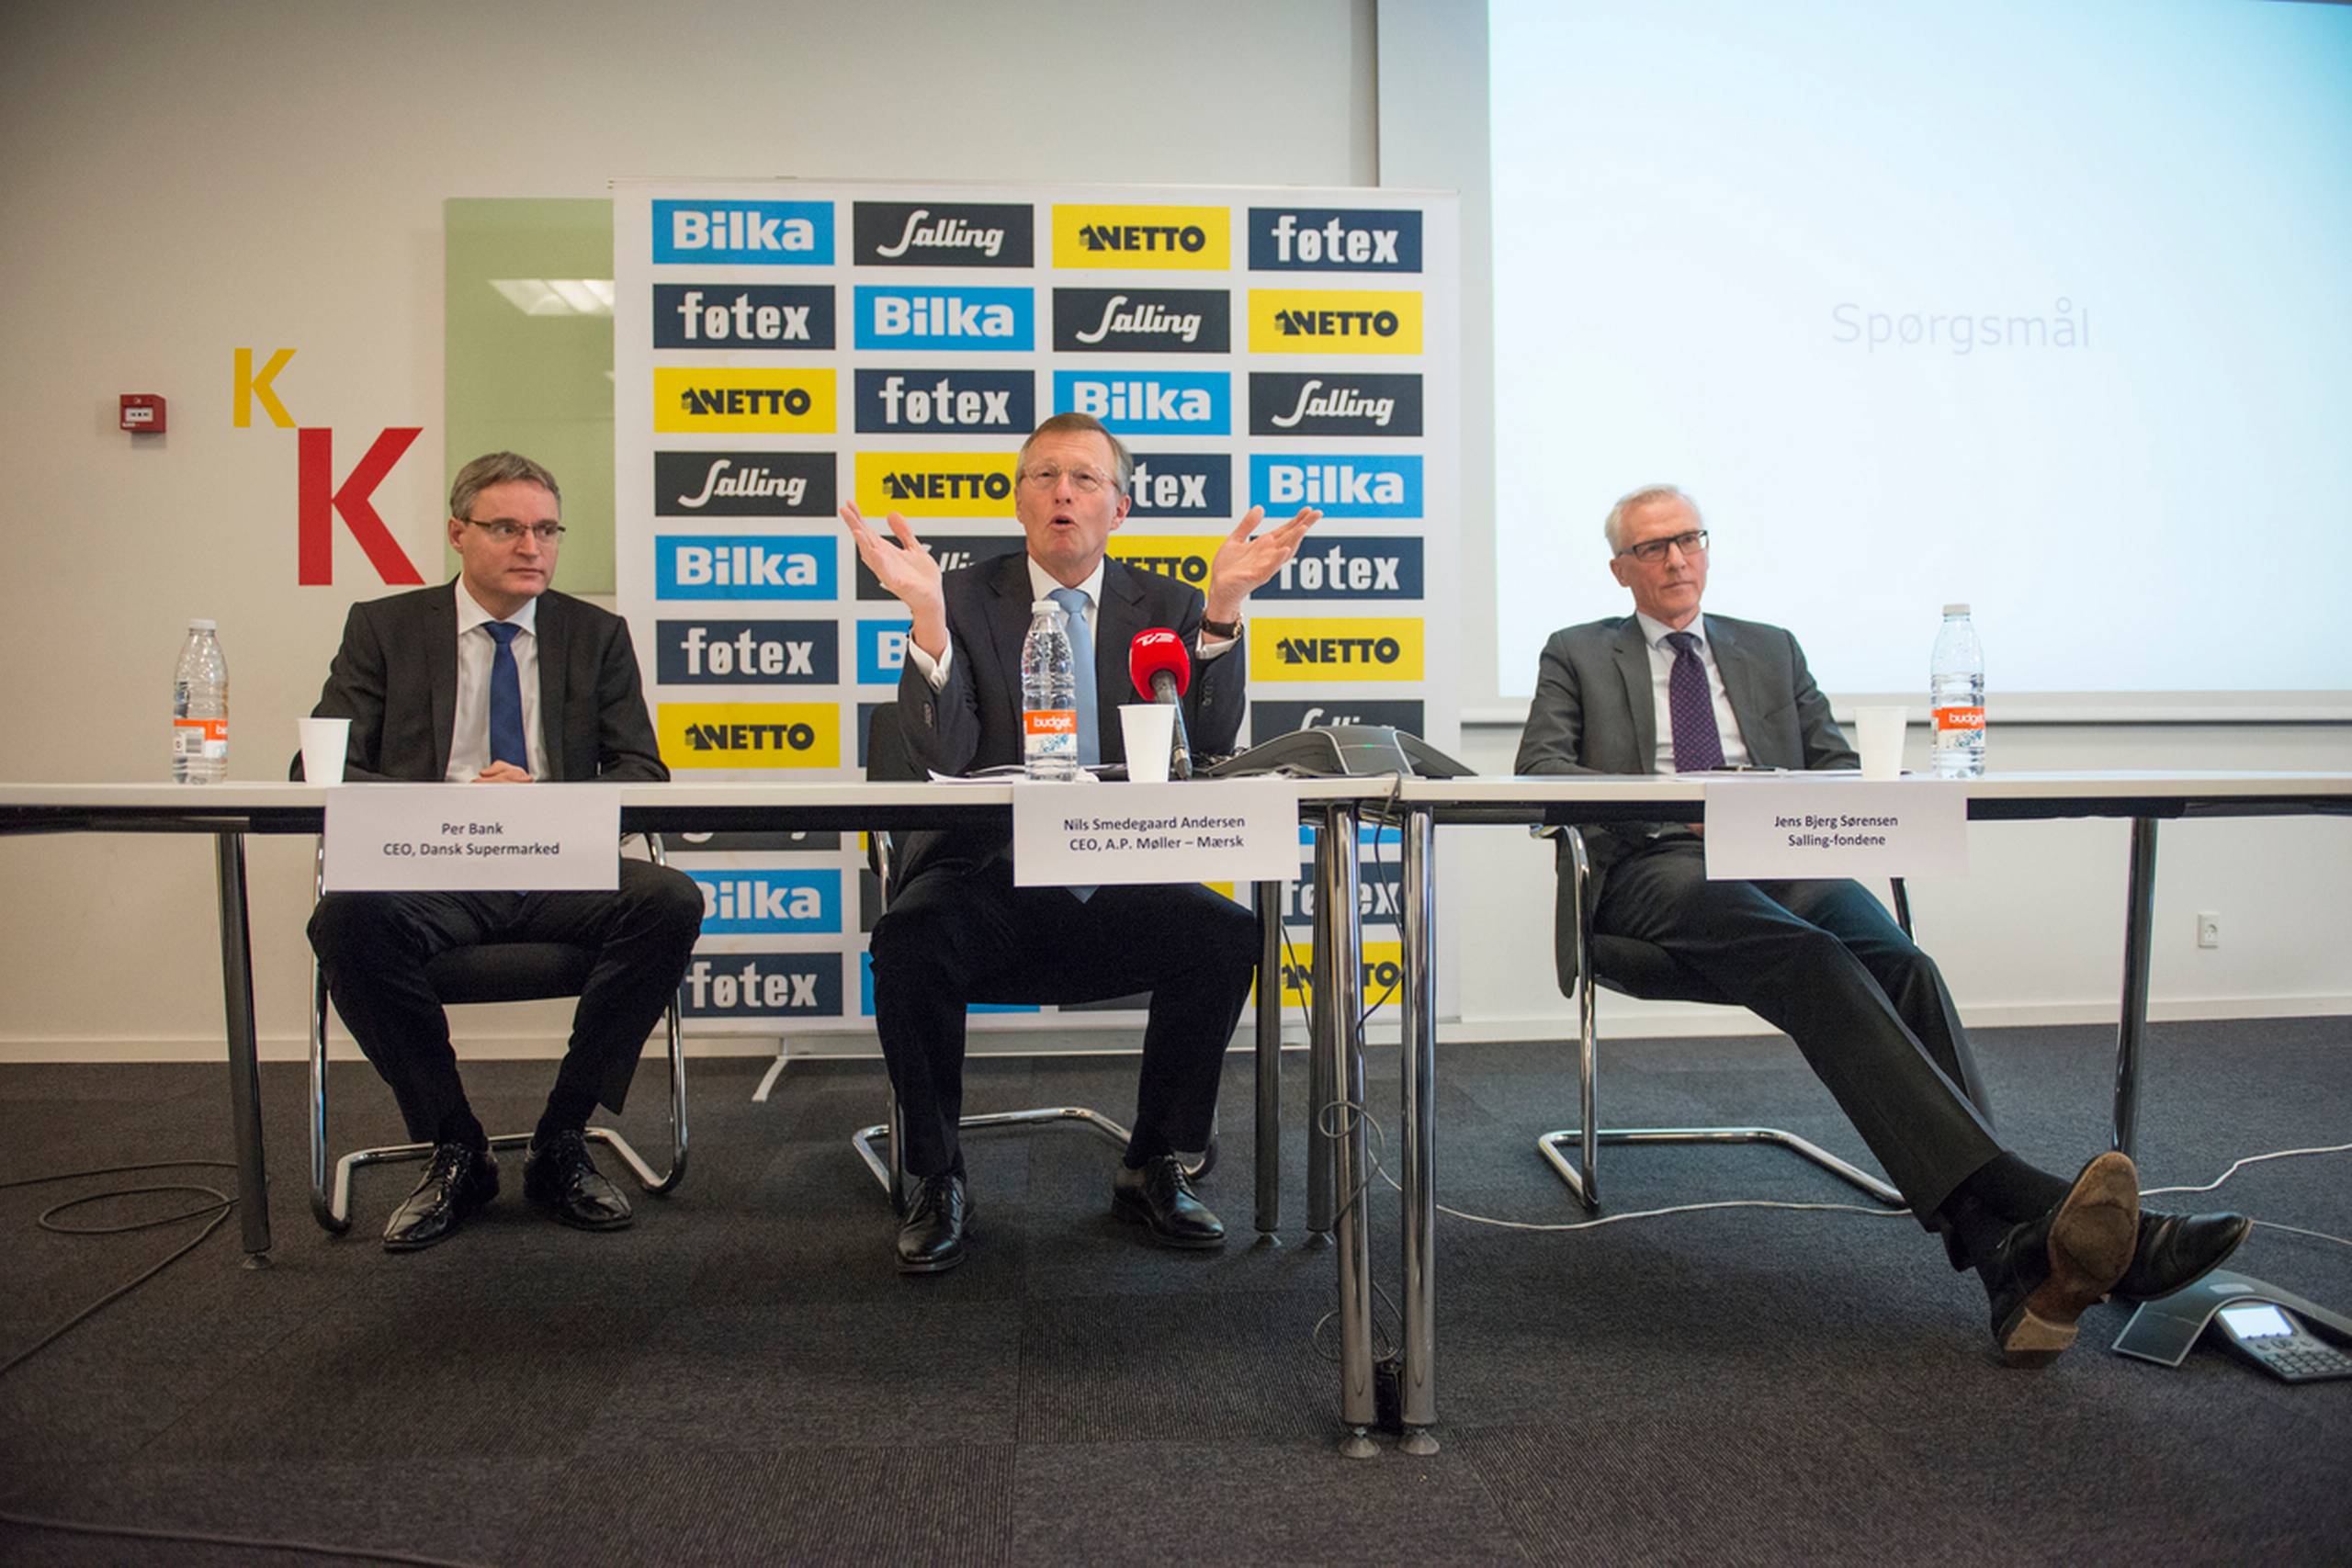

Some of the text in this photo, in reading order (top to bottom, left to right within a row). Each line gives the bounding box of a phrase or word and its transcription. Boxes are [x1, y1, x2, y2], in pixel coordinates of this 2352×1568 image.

[673, 211, 814, 250] Bilka
[876, 210, 1004, 256] Salling
[1097, 226, 1205, 253] NETTO
[1272, 216, 1398, 264] føtex
[678, 292, 809, 339] føtex
[875, 297, 1013, 336] Bilka
[1076, 296, 1201, 343] Salling
[1293, 310, 1398, 337] NETTO
[1832, 296, 2088, 355] Spørgsmål
[233, 348, 297, 428] K
[698, 389, 811, 415] NETTO
[879, 378, 1010, 423] føtex
[1073, 382, 1211, 420] Bilka
[1272, 380, 1394, 426] Salling
[678, 460, 807, 507] Salling
[900, 473, 1011, 500] NETTO
[1130, 462, 1207, 508] tex
[1269, 466, 1404, 504] Bilka
[299, 427, 426, 586] K
[676, 547, 817, 586] Bilka
[681, 628, 813, 674] føtex
[1294, 637, 1399, 663] NETTO
[708, 723, 814, 750] NETTO
[441, 822, 503, 835] Per Bank
[1064, 816, 1245, 831] Nils Smedegaard Andersen
[1774, 815, 1898, 830] Jens Bjerg Sørensen
[1788, 834, 1885, 848] Salling-fondene
[383, 842, 560, 857] CEO, Dansk Supermarked
[1070, 839, 1102, 852] CEO,
[1105, 839, 1132, 850] A.P.
[1136, 837, 1182, 850] Møller
[1197, 835, 1244, 848] Mærsk
[686, 962, 817, 1008] føtex
